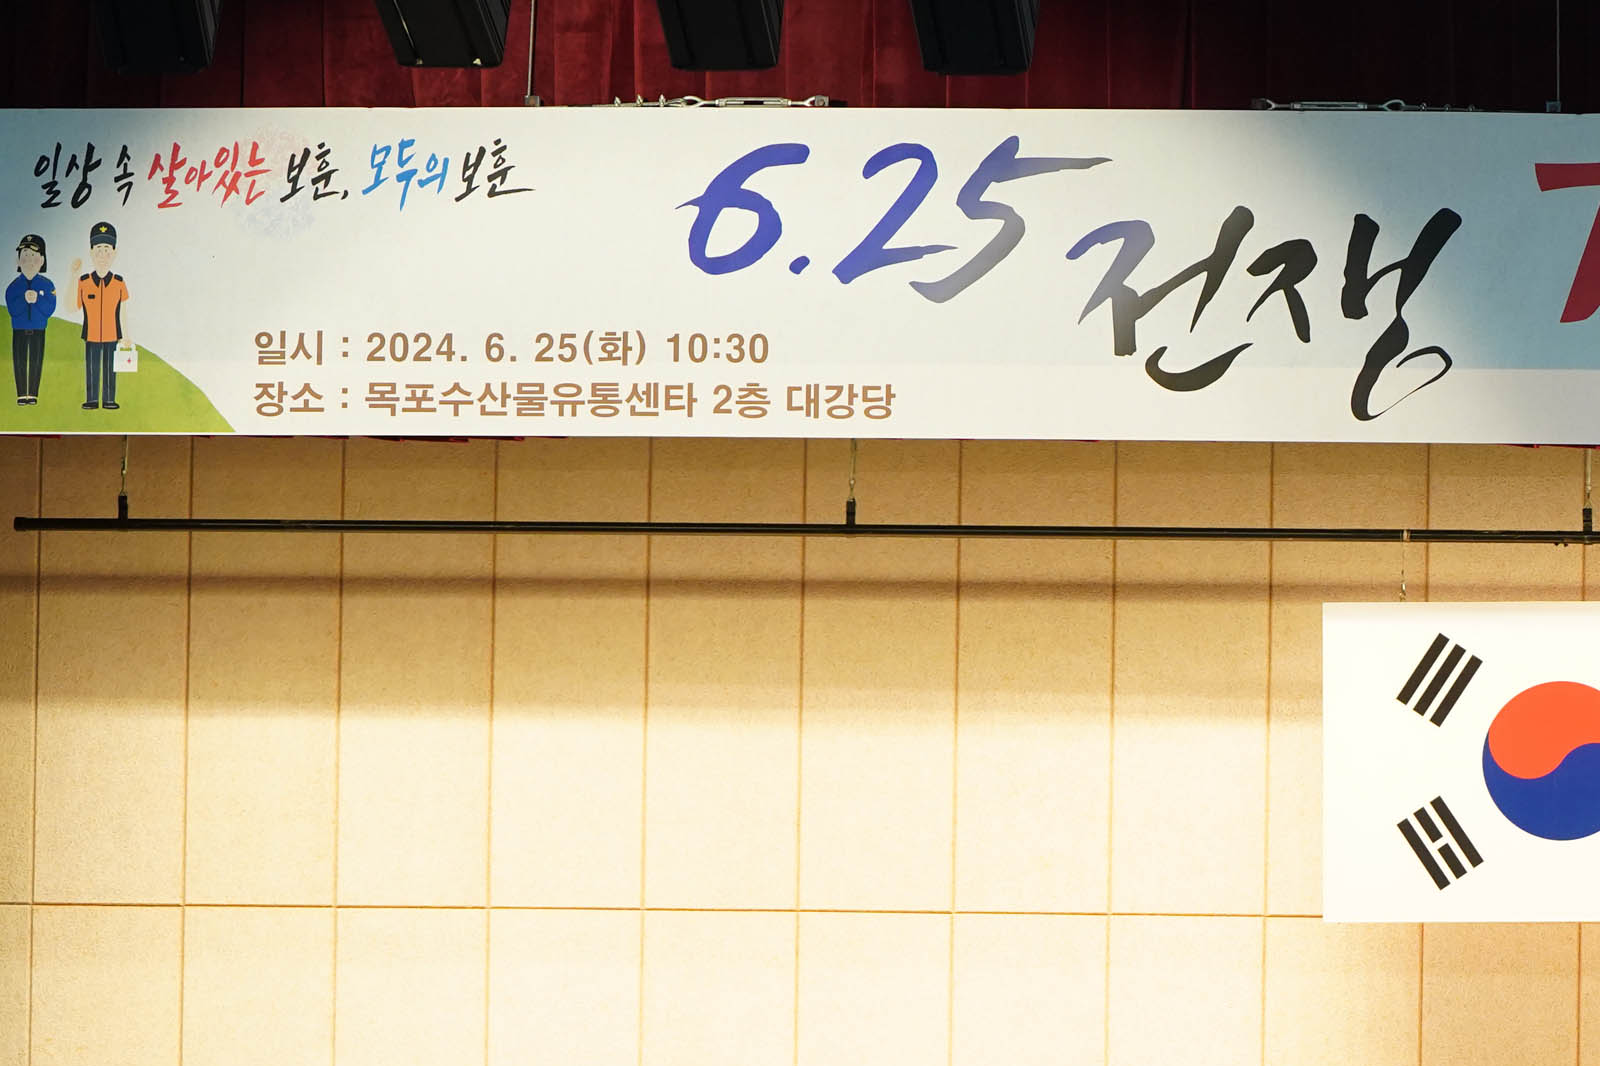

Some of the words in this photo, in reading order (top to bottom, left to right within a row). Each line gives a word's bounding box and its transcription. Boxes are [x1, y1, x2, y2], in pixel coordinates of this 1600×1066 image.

[33, 141, 102, 209] 일상
[113, 144, 135, 208] 속
[147, 141, 273, 209] 살아있는
[279, 142, 349, 202] 보훈,
[361, 138, 450, 212] 모두의
[453, 138, 537, 203] 보훈
[675, 135, 1113, 304] 6.25
[1065, 205, 1463, 422] 전쟁
[254, 330, 323, 365] 일시
[366, 332, 468, 363] 2024.
[485, 332, 518, 363] 6.
[535, 330, 647, 366] 25(화)
[666, 332, 770, 364] 10:30
[254, 381, 325, 417] 장소
[365, 382, 698, 418] 목포수산물유통센타
[712, 382, 771, 419] 2층
[786, 383, 897, 419] 대강당
